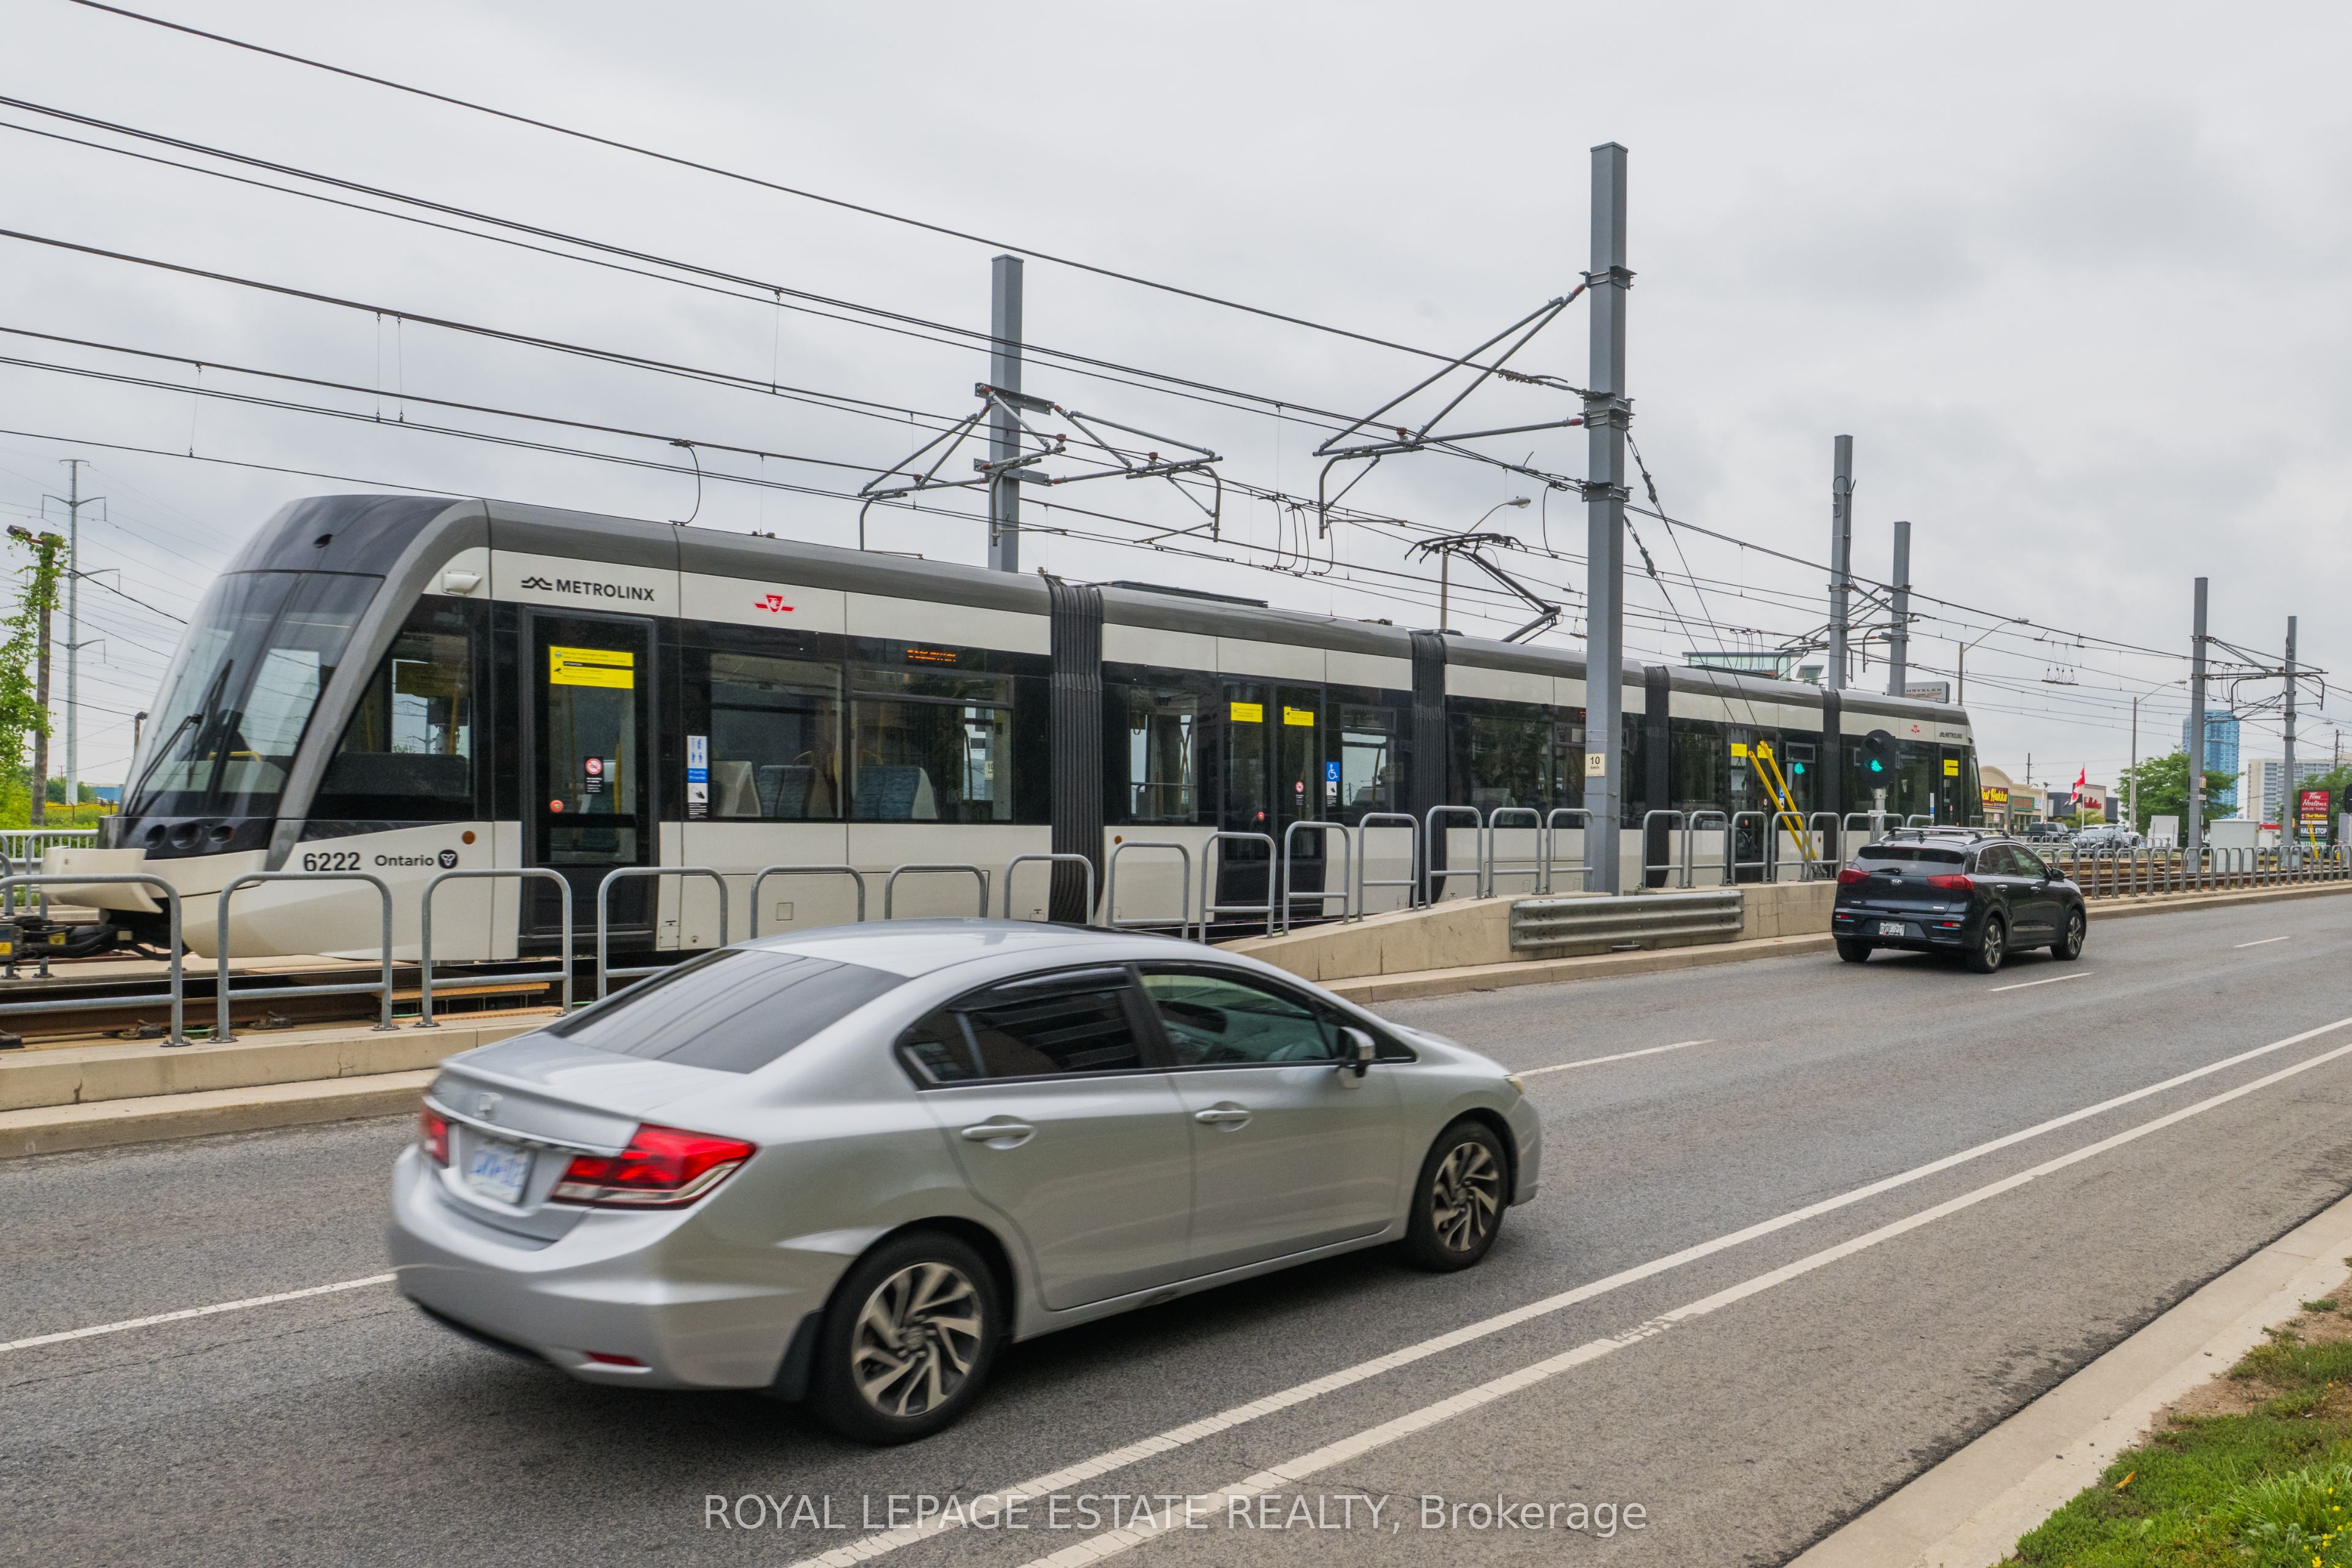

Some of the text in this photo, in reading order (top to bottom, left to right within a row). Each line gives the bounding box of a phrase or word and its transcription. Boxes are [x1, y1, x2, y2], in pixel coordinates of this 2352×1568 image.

[556, 579, 655, 601] METROLINX
[1991, 788, 2007, 802] Hakka
[303, 852, 361, 872] 6222
[374, 854, 434, 866] Ontario
